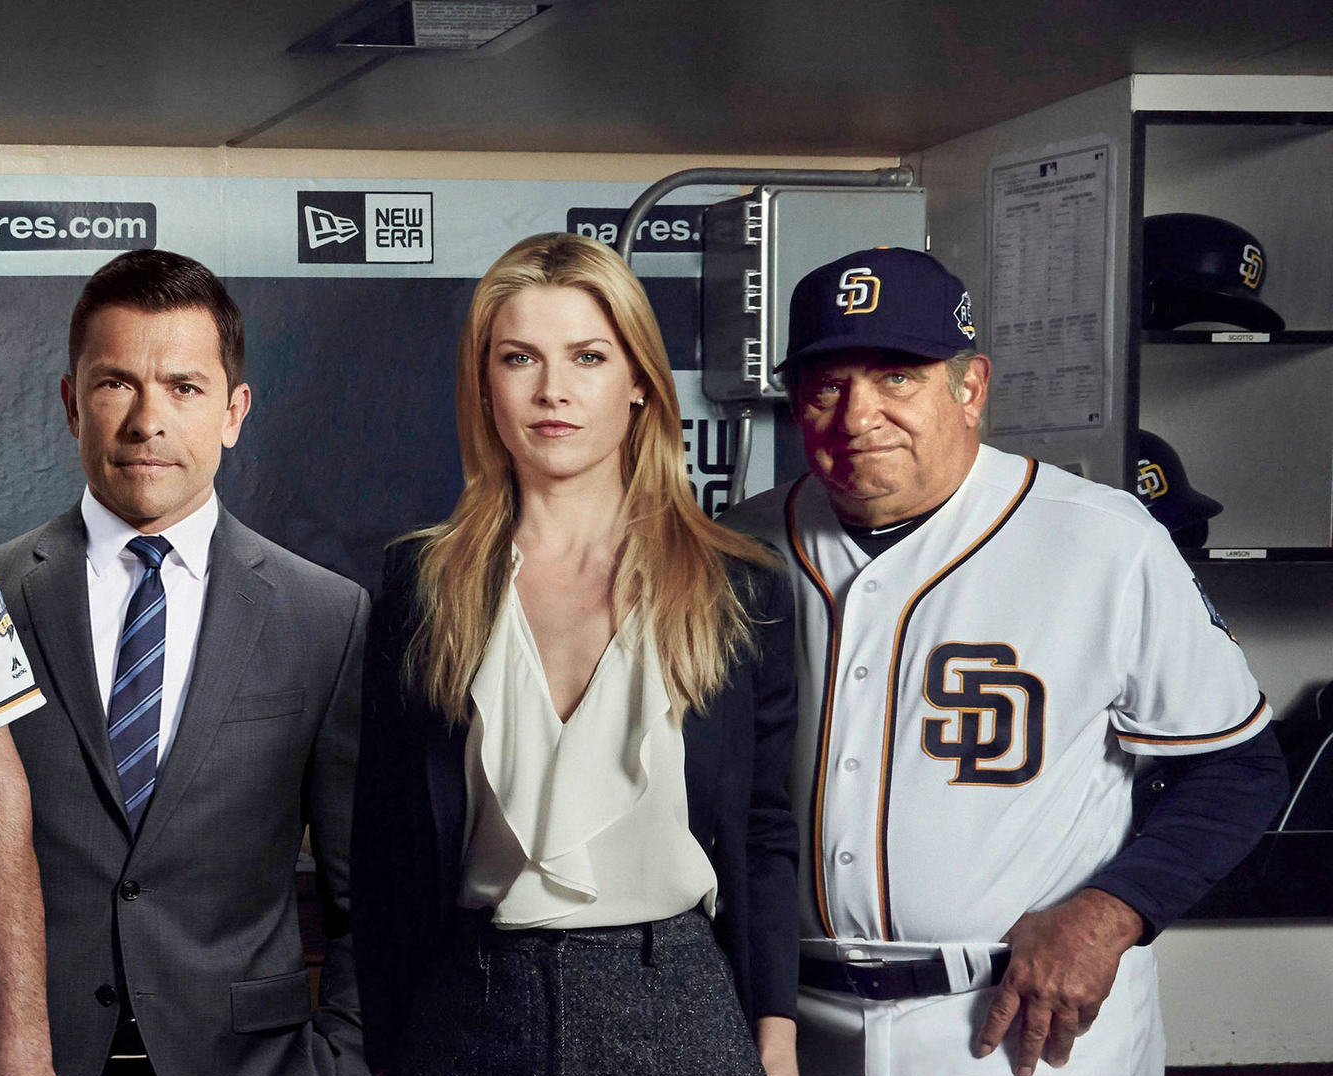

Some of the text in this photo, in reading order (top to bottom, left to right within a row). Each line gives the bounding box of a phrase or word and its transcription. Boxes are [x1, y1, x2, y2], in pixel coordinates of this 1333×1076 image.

[375, 208, 423, 227] NEW
[376, 229, 423, 248] ERA
[1239, 244, 1264, 289] SD
[836, 267, 881, 315] SD
[921, 640, 1047, 788] SD
